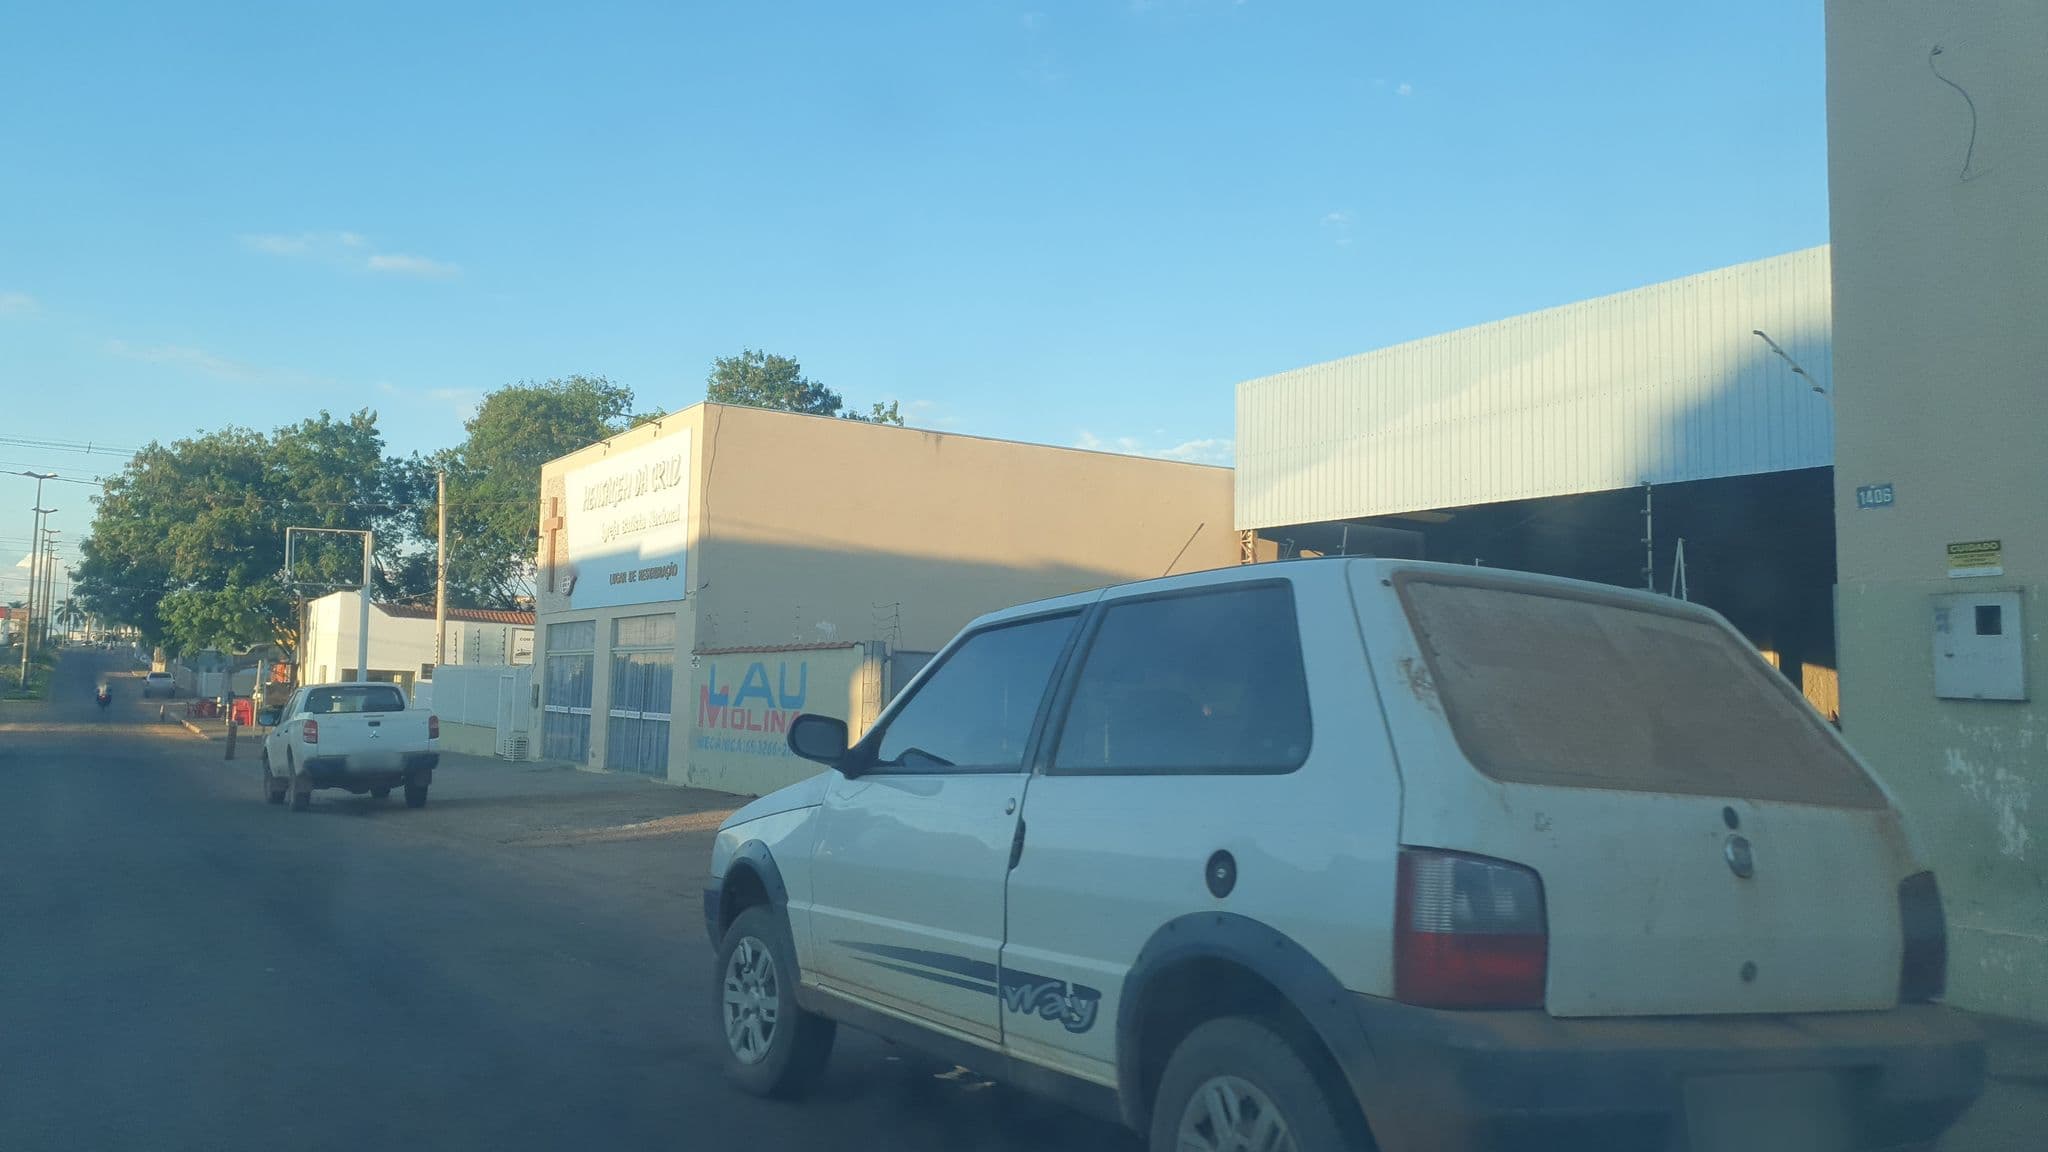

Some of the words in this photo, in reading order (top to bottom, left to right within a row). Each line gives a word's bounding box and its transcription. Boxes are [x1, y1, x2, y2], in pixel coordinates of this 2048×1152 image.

[635, 464, 648, 496] DA
[652, 454, 681, 492] CRUZ
[1859, 488, 1892, 505] 1406
[628, 570, 637, 582] DE
[709, 661, 807, 709] LAU
